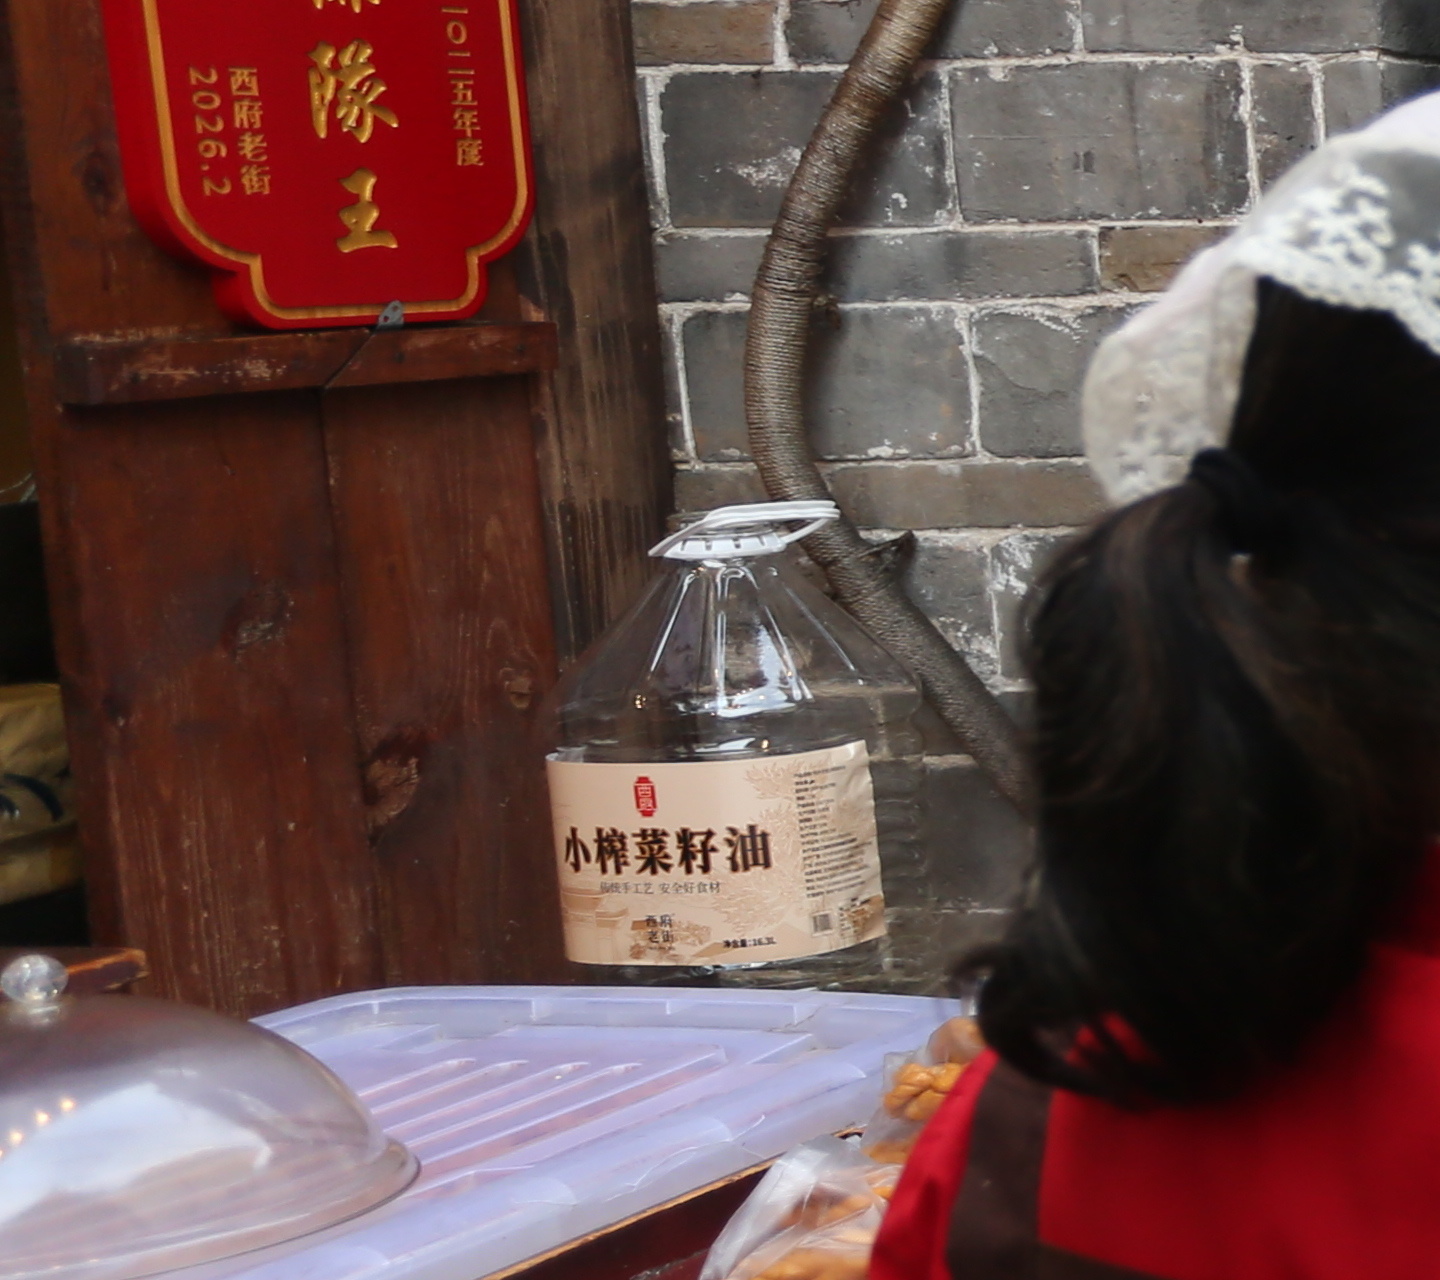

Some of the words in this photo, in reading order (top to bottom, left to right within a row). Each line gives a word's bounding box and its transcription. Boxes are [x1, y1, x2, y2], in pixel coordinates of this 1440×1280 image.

[188, 68, 233, 197] 2026.2
[228, 66, 270, 196] 西府老街
[564, 823, 774, 876] 小榨菜籽油
[658, 881, 722, 895] 安全好食材
